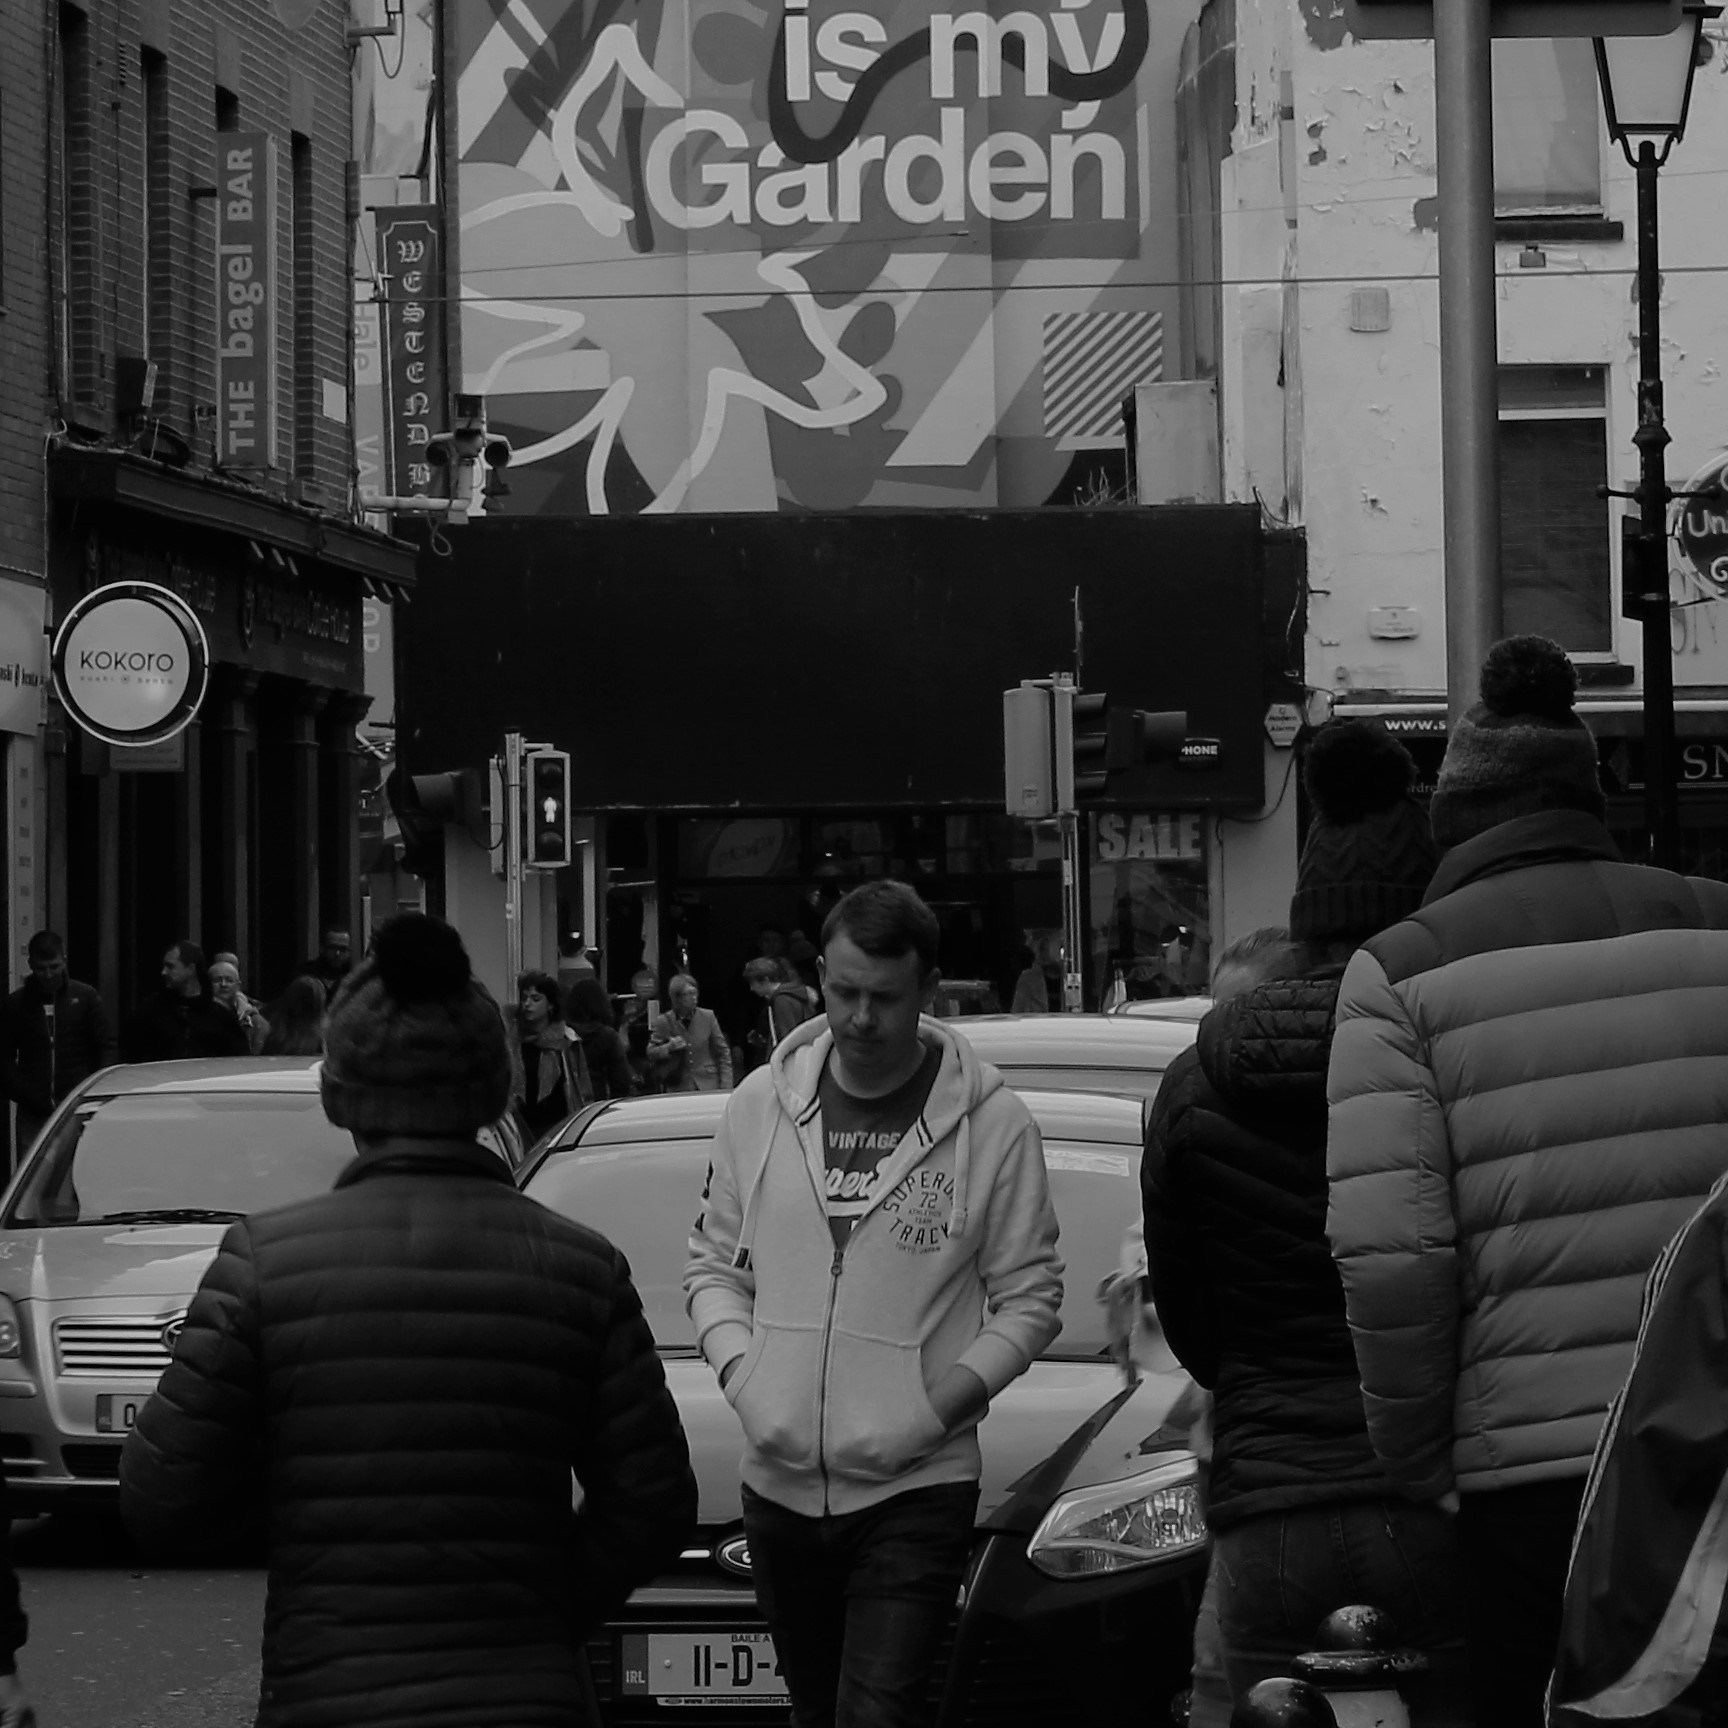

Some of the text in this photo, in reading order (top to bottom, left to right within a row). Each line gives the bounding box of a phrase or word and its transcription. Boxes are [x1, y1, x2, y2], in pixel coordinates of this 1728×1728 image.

[929, 10, 1125, 129] my
[646, 108, 1129, 228] Garden
[221, 147, 264, 455] THE bagel BAR
[1384, 719, 1447, 731] www.s
[1181, 745, 1218, 756] HONE
[1097, 813, 1203, 861] SALE
[828, 1130, 901, 1150] VINTAGE
[920, 1191, 938, 1209] 72
[730, 1634, 759, 1644] BAILE
[625, 1669, 646, 1684] IRL
